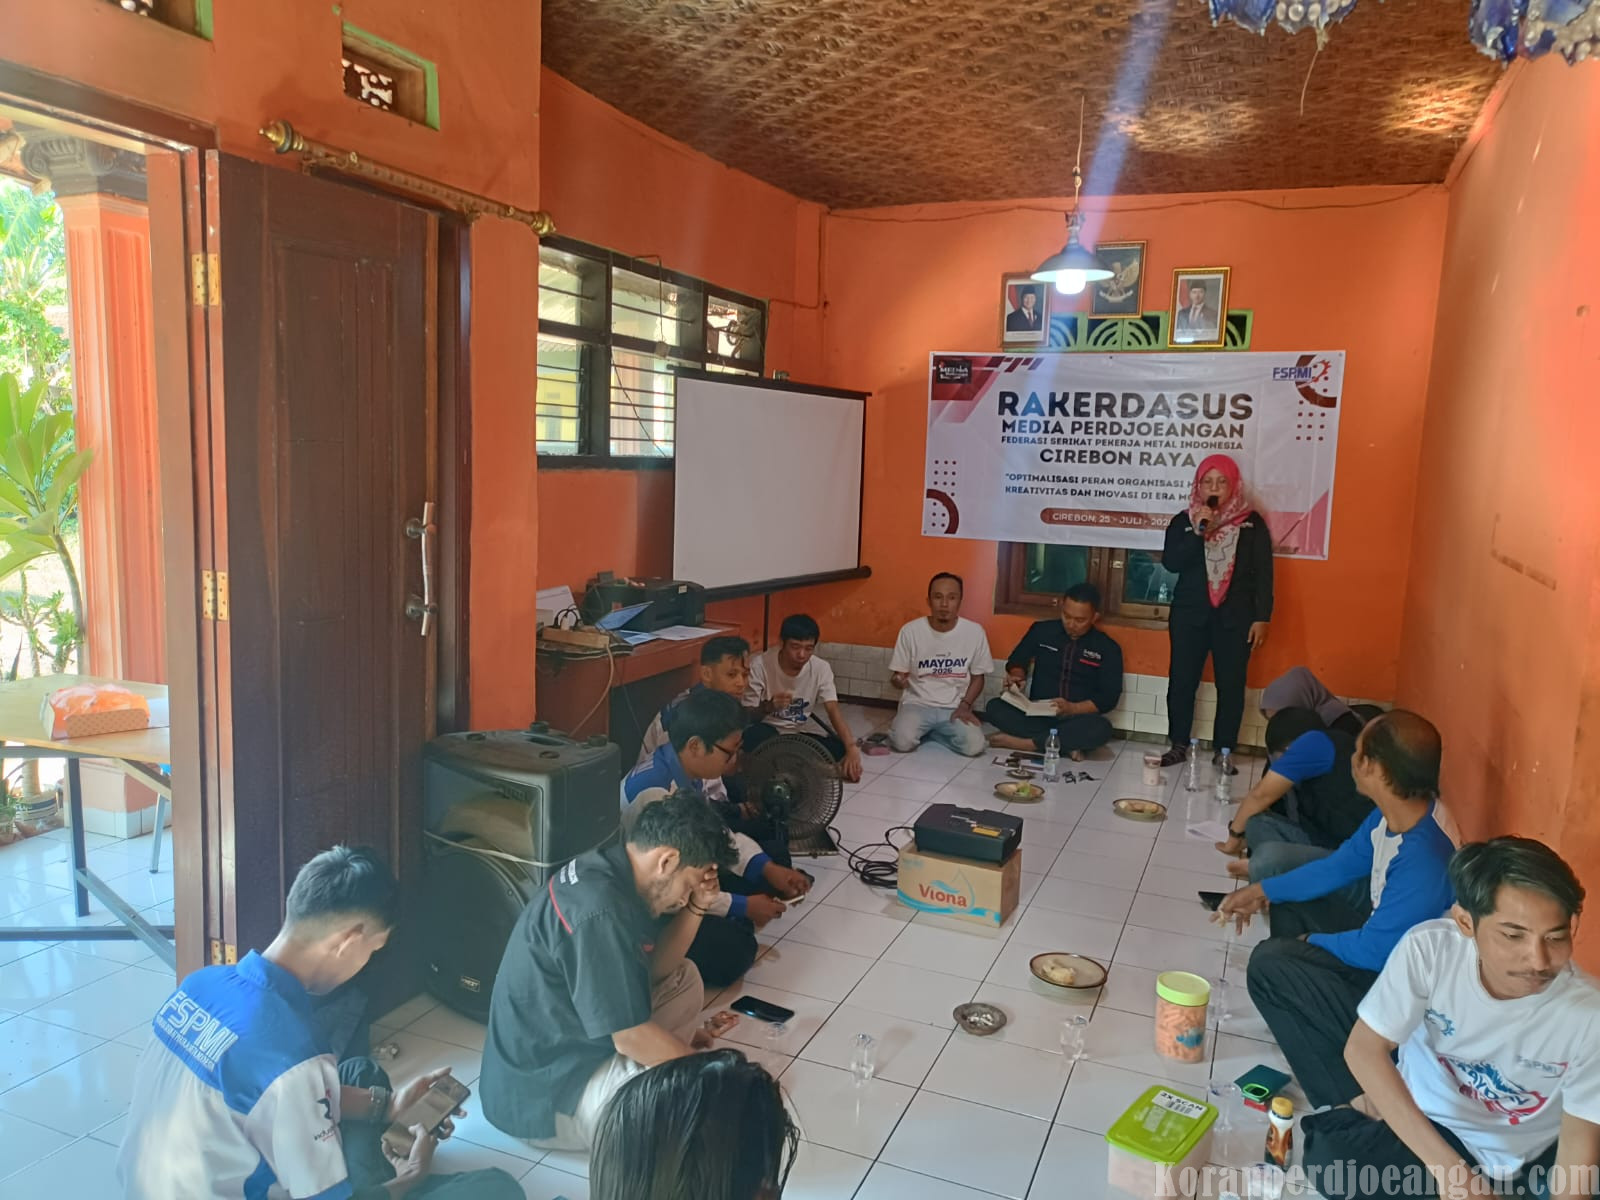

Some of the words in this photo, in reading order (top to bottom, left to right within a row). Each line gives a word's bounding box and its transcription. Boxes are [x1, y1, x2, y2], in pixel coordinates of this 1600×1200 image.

[1272, 366, 1312, 379] FSPMI
[998, 391, 1253, 420] RAKERDASUS
[1002, 419, 1064, 434] MEDIA
[1071, 421, 1244, 438] PERDJOEANGAN
[1001, 435, 1048, 444] FEDERASI
[1050, 437, 1092, 446] SERIKAT
[1095, 438, 1141, 448] PEKERJA
[1144, 440, 1177, 448] METAL
[1180, 440, 1243, 450] INDONESIA
[1039, 448, 1132, 465] CIREBON
[1139, 451, 1196, 467] RAYA
[1081, 476, 1114, 485] PERAN
[1117, 477, 1184, 488] ORGANISASI
[1005, 485, 1068, 496] KREATIVITAS
[1070, 488, 1091, 497] DAN
[1094, 490, 1138, 499] INOVASI
[1141, 491, 1152, 500] DI
[1156, 492, 1176, 500] ERA
[1120, 516, 1142, 525] JULI
[1151, 518, 1170, 527] 202
[918, 657, 968, 669] MAYDAY
[919, 883, 967, 908] Viona
[159, 990, 239, 1063] FSPMI
[1161, 1092, 1173, 1100] 2X
[1175, 1098, 1204, 1111] SCAN
